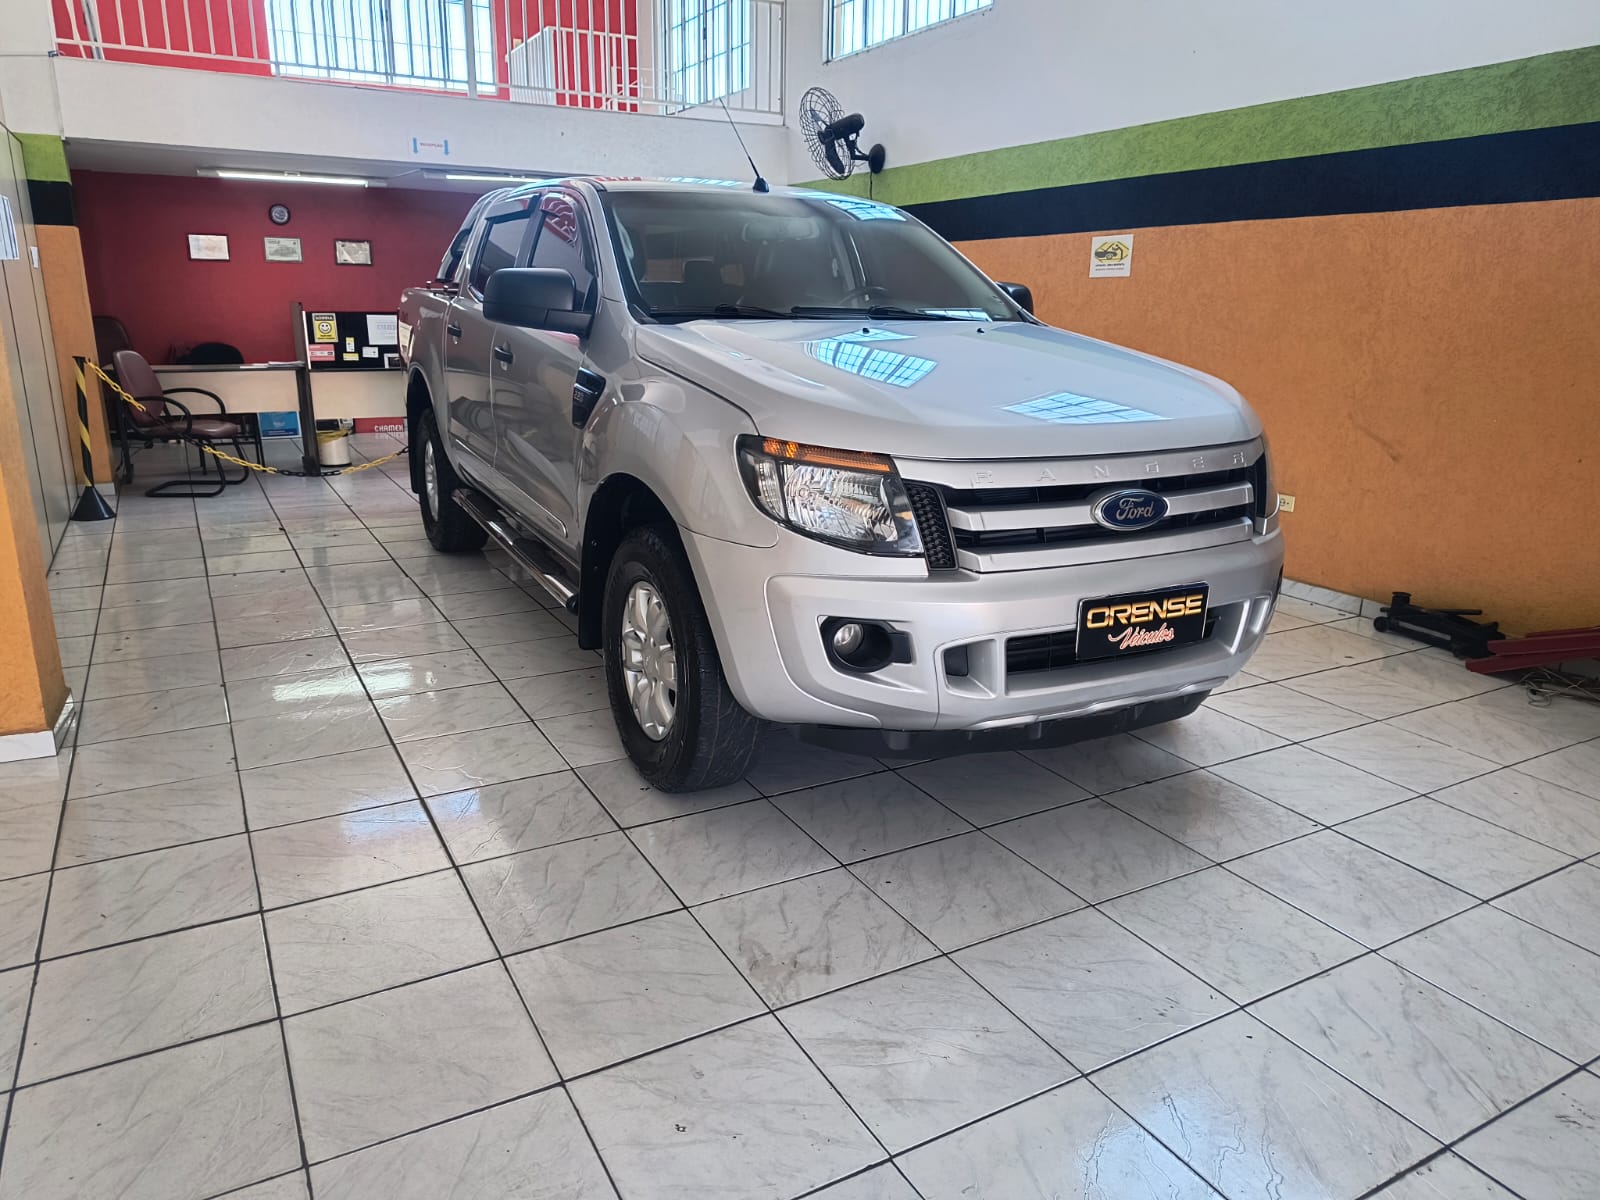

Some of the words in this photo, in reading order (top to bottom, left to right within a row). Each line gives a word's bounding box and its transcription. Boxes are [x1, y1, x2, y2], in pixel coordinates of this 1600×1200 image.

[975, 451, 1247, 483] RANGER
[1116, 498, 1155, 520] Ford
[1087, 594, 1203, 628] ORENSE
